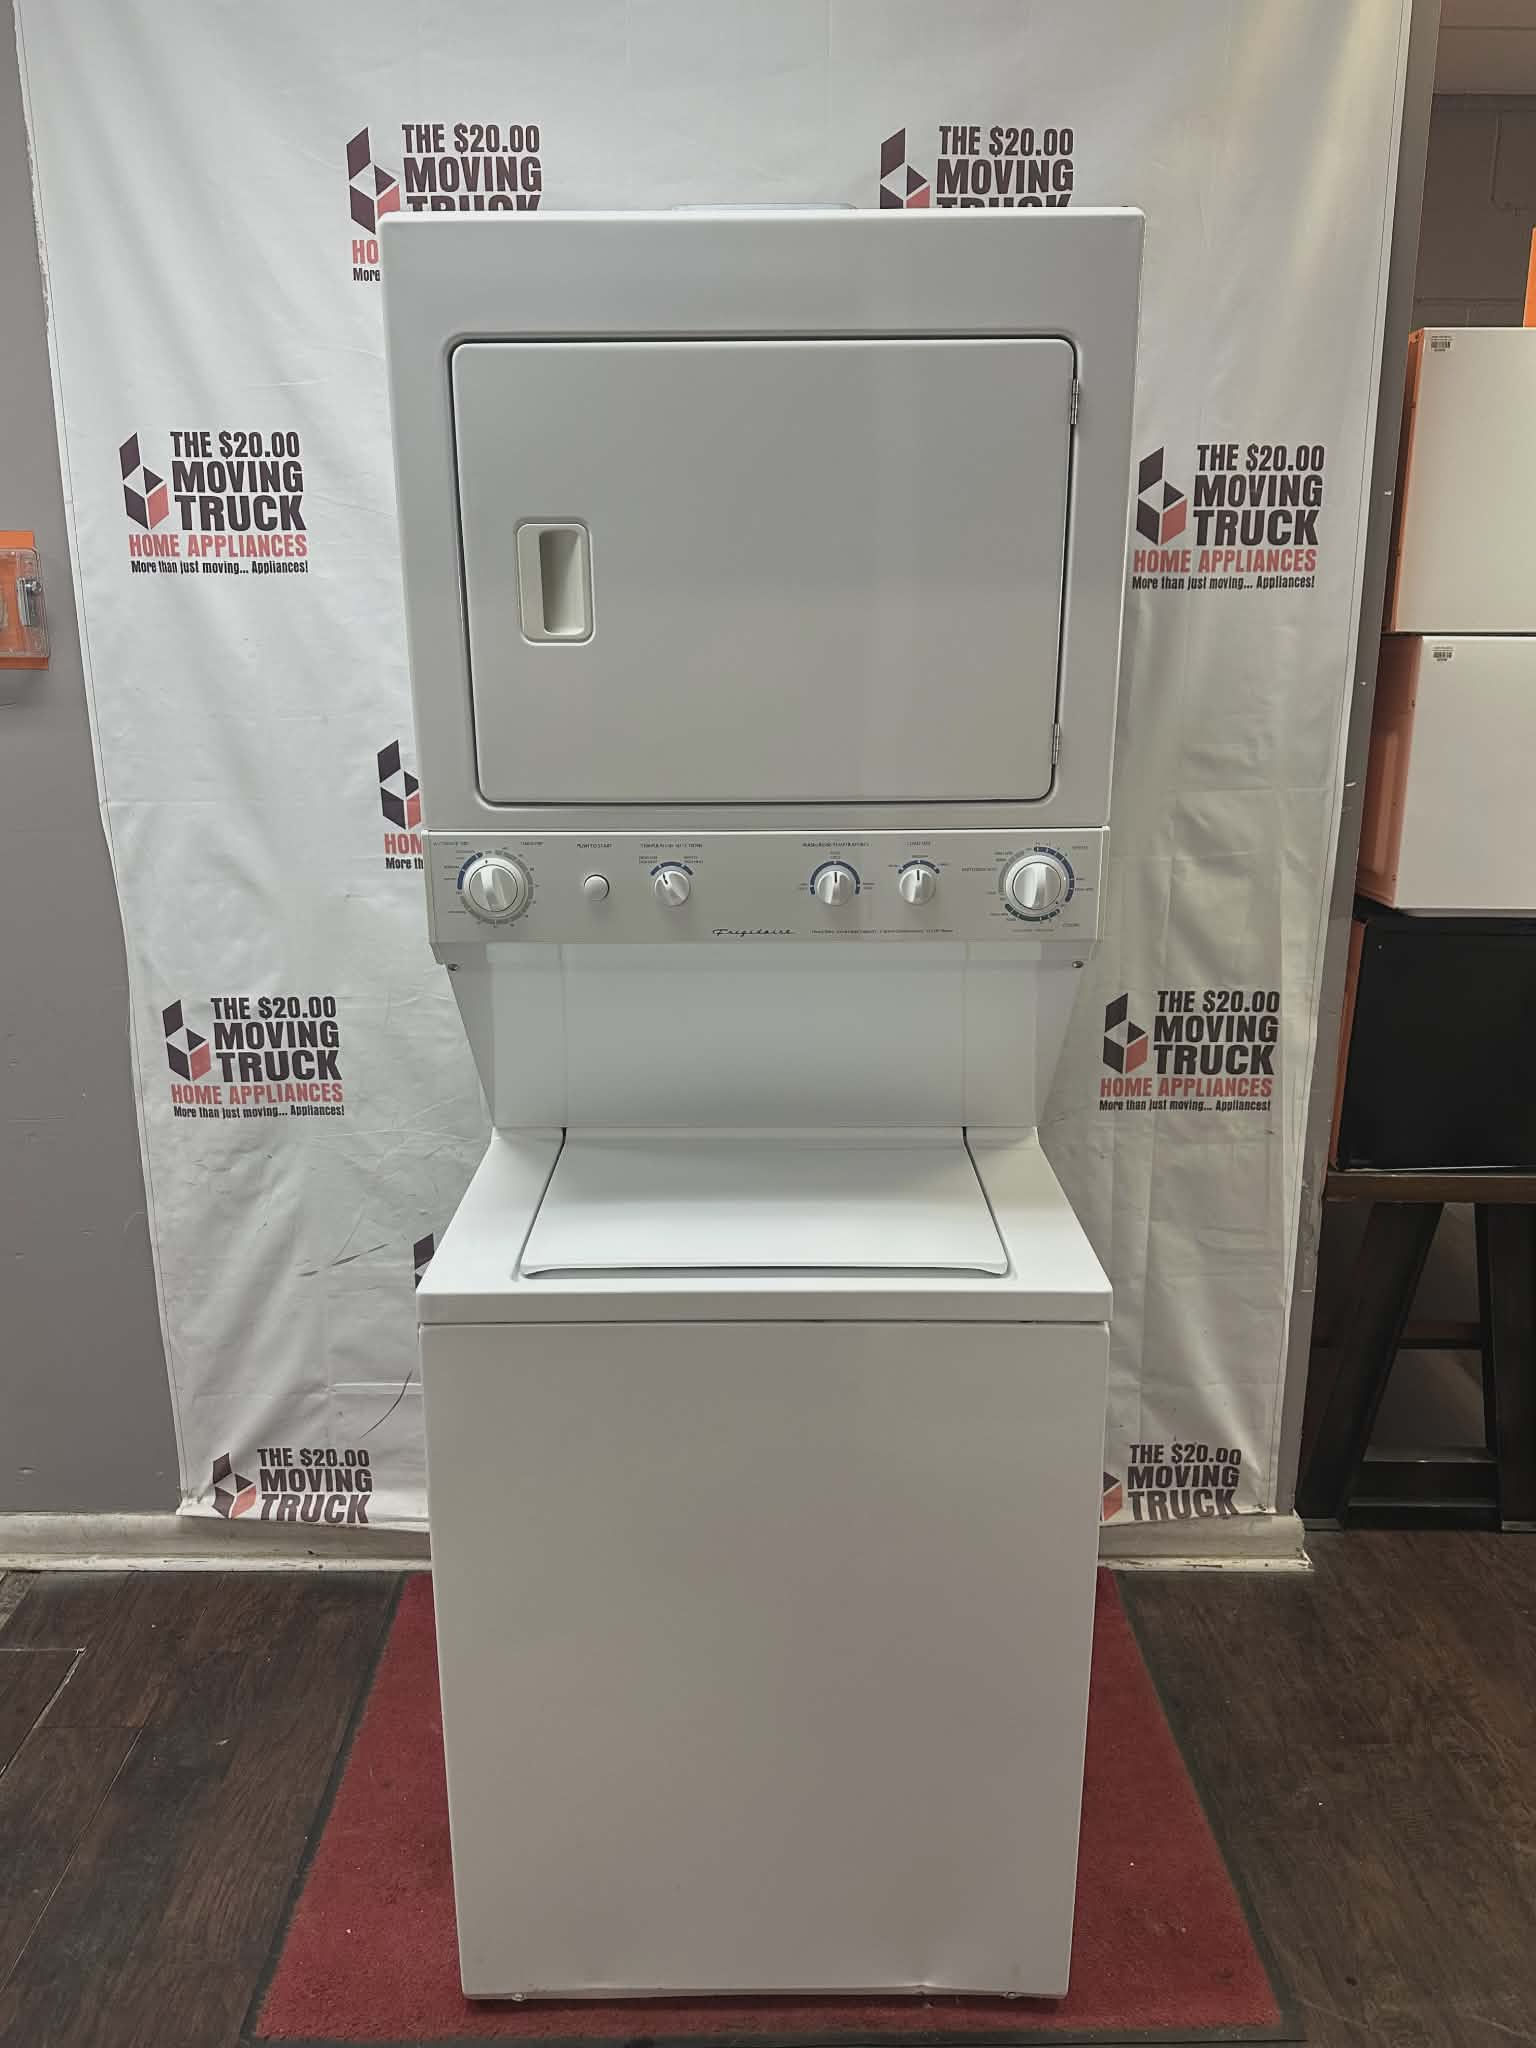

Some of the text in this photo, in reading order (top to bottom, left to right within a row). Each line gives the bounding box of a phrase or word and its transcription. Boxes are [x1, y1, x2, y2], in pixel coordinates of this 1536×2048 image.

[402, 123, 540, 154] THE $20.00
[939, 126, 1074, 157] THE $20.00
[404, 156, 542, 192] MOVING
[936, 159, 1074, 194] MOVING
[352, 240, 379, 264] HO
[170, 431, 300, 459] THE $20.00
[1197, 443, 1325, 472] THE $20.00
[172, 460, 304, 493] MOVING
[1193, 474, 1323, 507] MOVING
[175, 494, 307, 531] TRUCK
[1193, 509, 1319, 546] TRUCK
[129, 534, 307, 558] HOME APPLIANCES
[131, 560, 308, 574] More than just moving... Appliances!
[1133, 549, 1317, 573] HOME APPLIANCES
[1132, 575, 1315, 590] More than just moving... Appliances!
[384, 833, 422, 854] HOM
[385, 857, 412, 870] More
[210, 996, 336, 1020] THE $20.00
[1157, 990, 1280, 1014] THE $20.00
[213, 1020, 340, 1050] MOVING
[1154, 1015, 1280, 1043] MOVING
[216, 1050, 342, 1082] TRUCK
[1154, 1045, 1275, 1075] TRUCK
[171, 1083, 344, 1105] HOME APPLIANCES
[1100, 1077, 1273, 1097] HOME APPLIANCES
[174, 1104, 344, 1120] More than just moving... Appliances!
[1099, 1099, 1271, 1112] More than just moving... Appliances!
[257, 1448, 370, 1468] THE $20.00
[1129, 1443, 1242, 1465] THE $20.00
[259, 1468, 373, 1493] MOVING
[1127, 1465, 1241, 1489] MOVING
[260, 1494, 371, 1524] TRUCK
[1127, 1489, 1239, 1521] TRUCK
